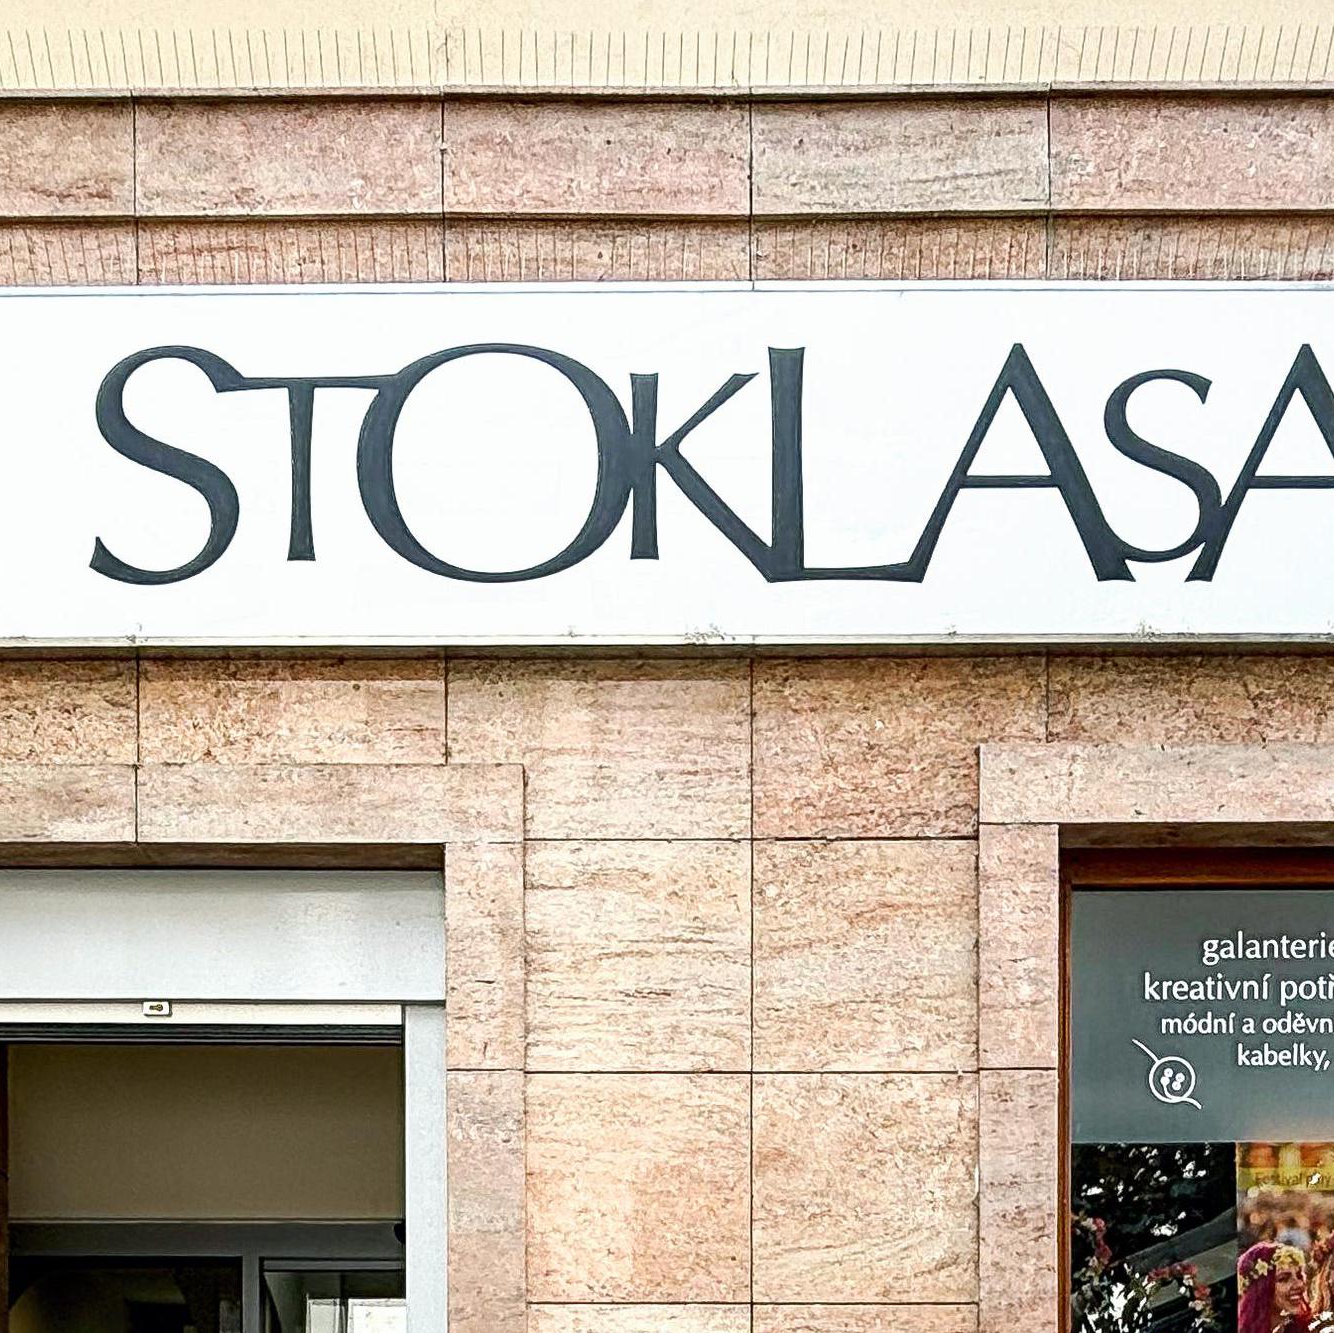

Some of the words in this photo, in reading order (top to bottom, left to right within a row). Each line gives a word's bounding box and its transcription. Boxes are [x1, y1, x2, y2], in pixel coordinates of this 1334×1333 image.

[1144, 971, 1272, 1000] kreativní
[1161, 1011, 1236, 1035] módní
[1242, 1017, 1256, 1034] a
[1237, 1042, 1331, 1073] kabelky,
